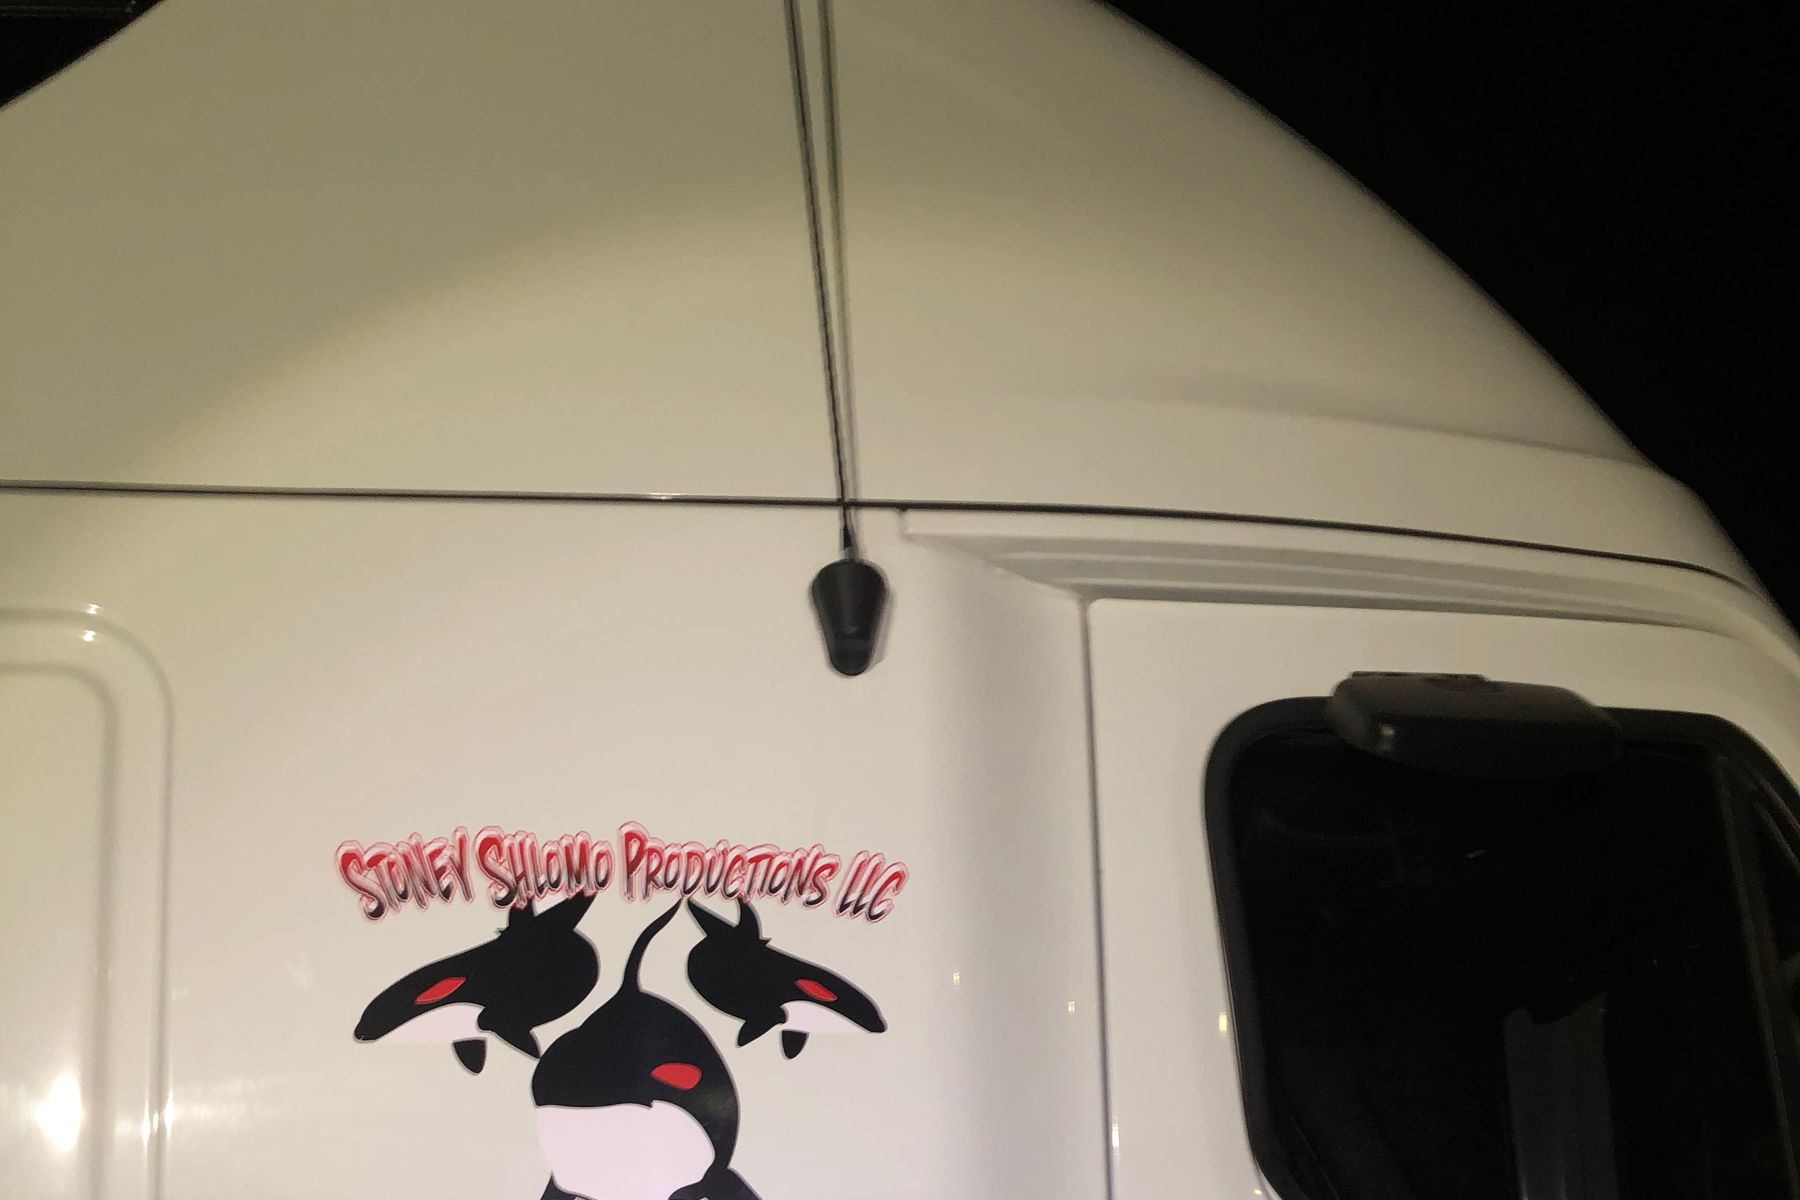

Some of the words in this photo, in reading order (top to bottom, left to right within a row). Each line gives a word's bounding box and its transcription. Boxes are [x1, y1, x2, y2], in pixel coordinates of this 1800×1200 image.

[335, 826, 475, 921] STONEY
[474, 825, 614, 909] SHLOMO
[618, 820, 840, 905] PRODUCTIONS
[832, 850, 909, 924] LLC
